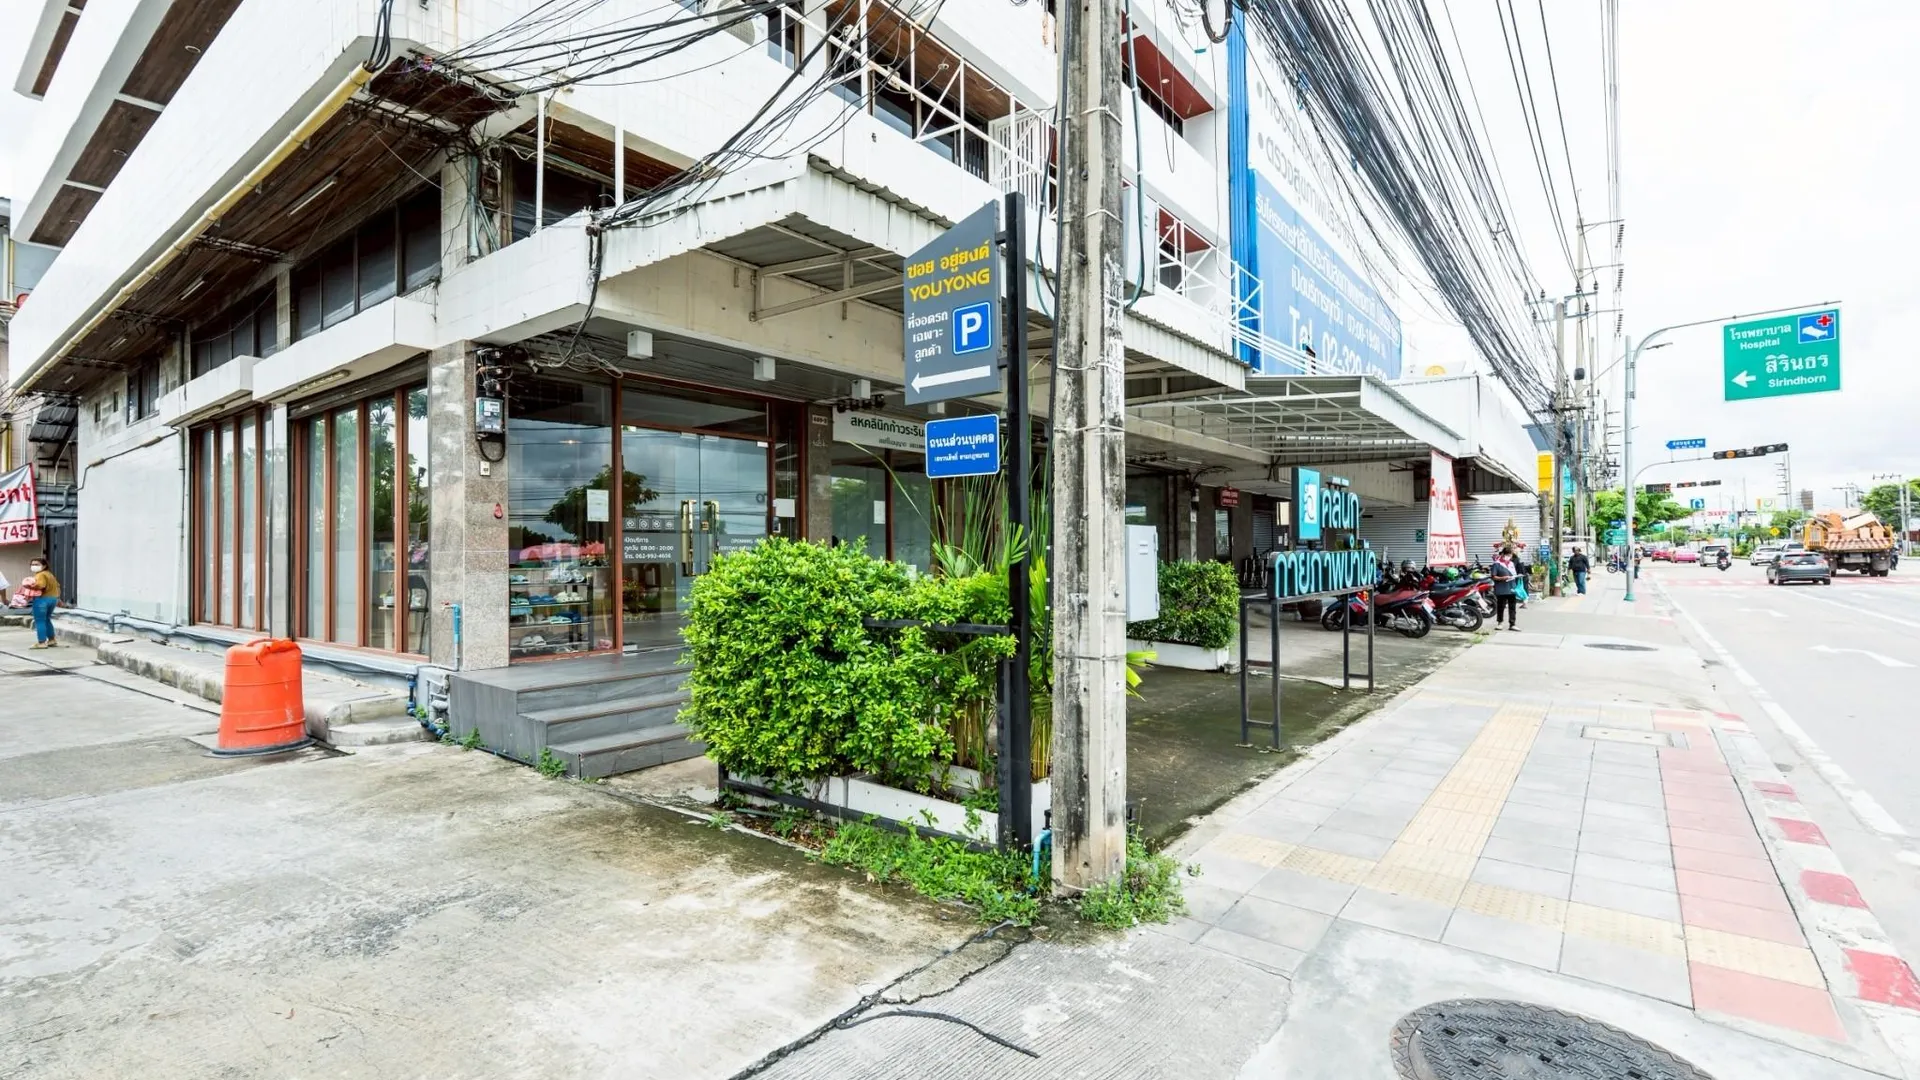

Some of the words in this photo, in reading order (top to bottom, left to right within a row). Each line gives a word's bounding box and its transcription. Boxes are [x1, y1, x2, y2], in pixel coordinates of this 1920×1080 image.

[912, 328, 944, 343] เฉพาะ
[961, 311, 982, 346] P
[1729, 324, 1792, 341] โรงพยาบาล
[1740, 338, 1780, 350] Hospital
[914, 344, 942, 362] ลูกค้า
[1765, 353, 1829, 374] สิรินธร
[1768, 374, 1827, 388] Sirindhorn
[929, 432, 995, 450] ถนนส่วนบุคคล
